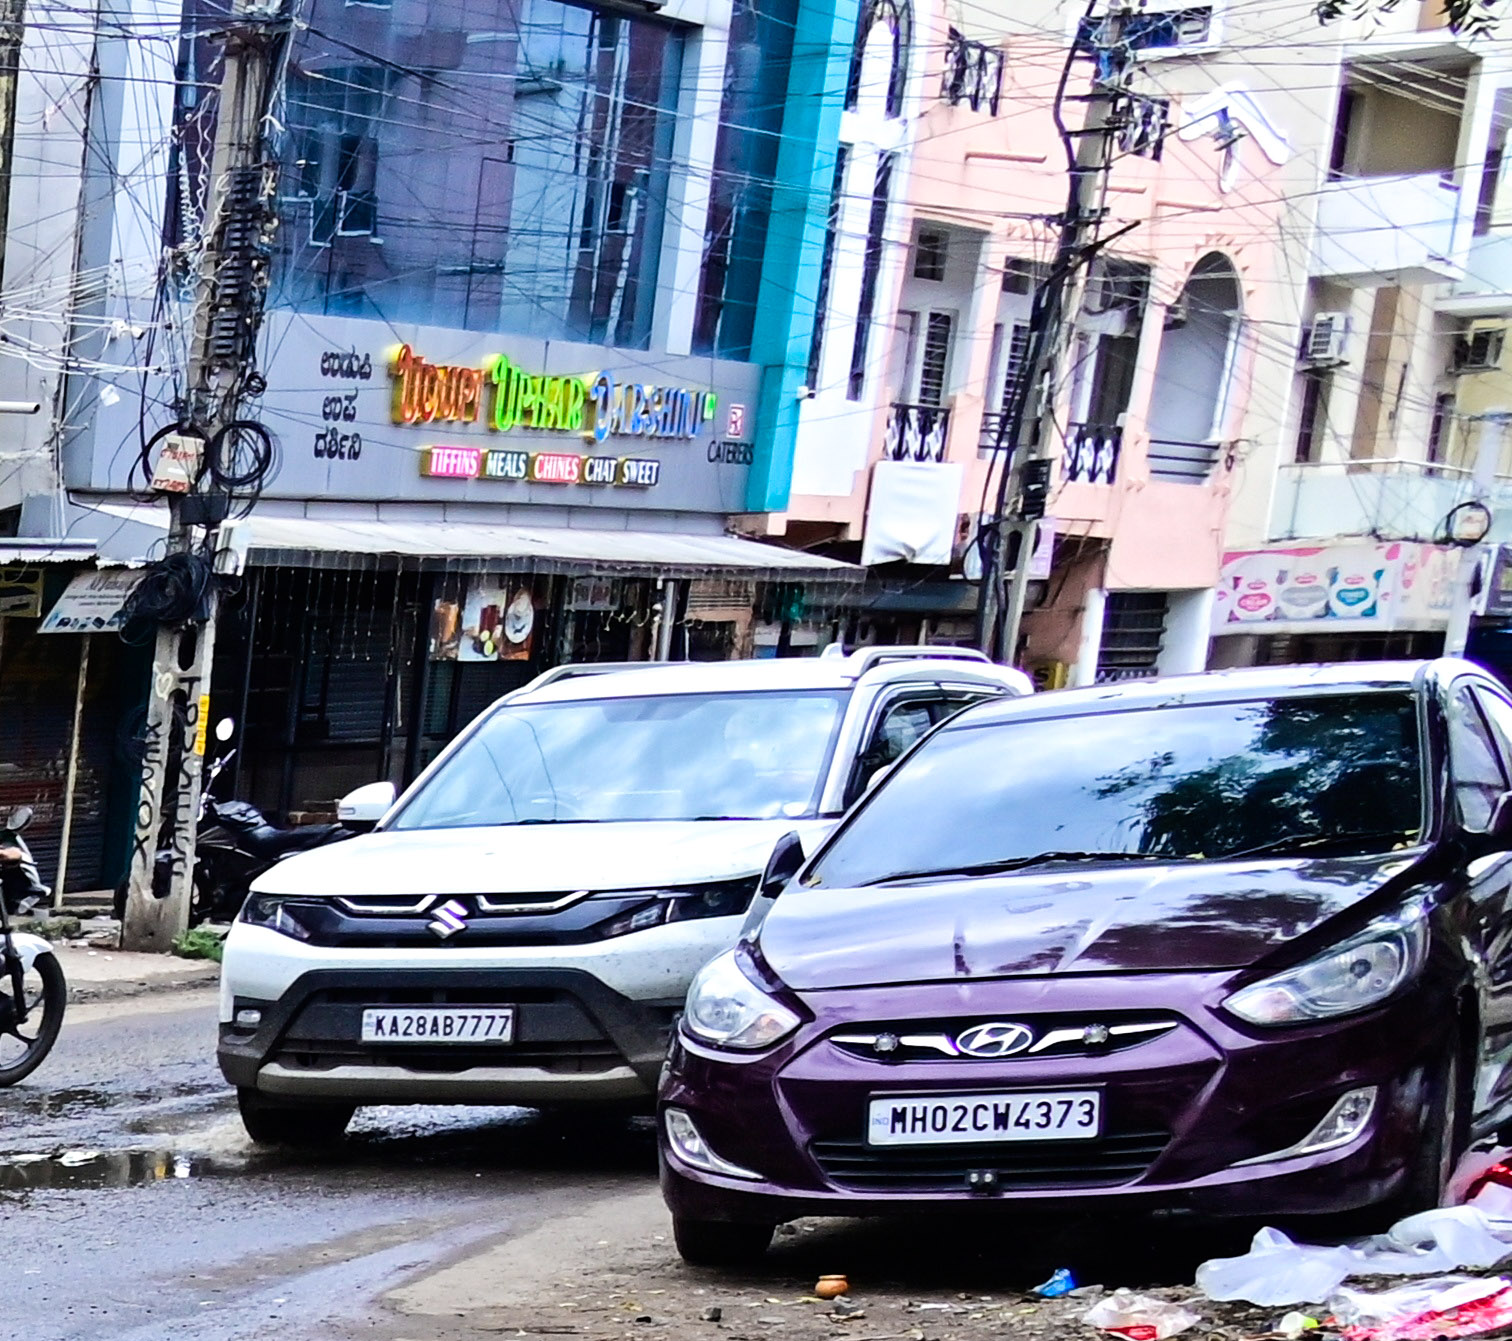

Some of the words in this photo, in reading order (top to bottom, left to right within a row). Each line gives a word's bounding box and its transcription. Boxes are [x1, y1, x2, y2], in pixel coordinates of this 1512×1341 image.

[429, 446, 480, 476] TIFFINS
[486, 451, 528, 479] MEALS
[534, 453, 579, 482] CHINES
[585, 457, 617, 483] CHAT
[622, 459, 659, 485] SWEET
[374, 1014, 510, 1037] KA28AB7777
[890, 1099, 1095, 1134] MH02CW4373
